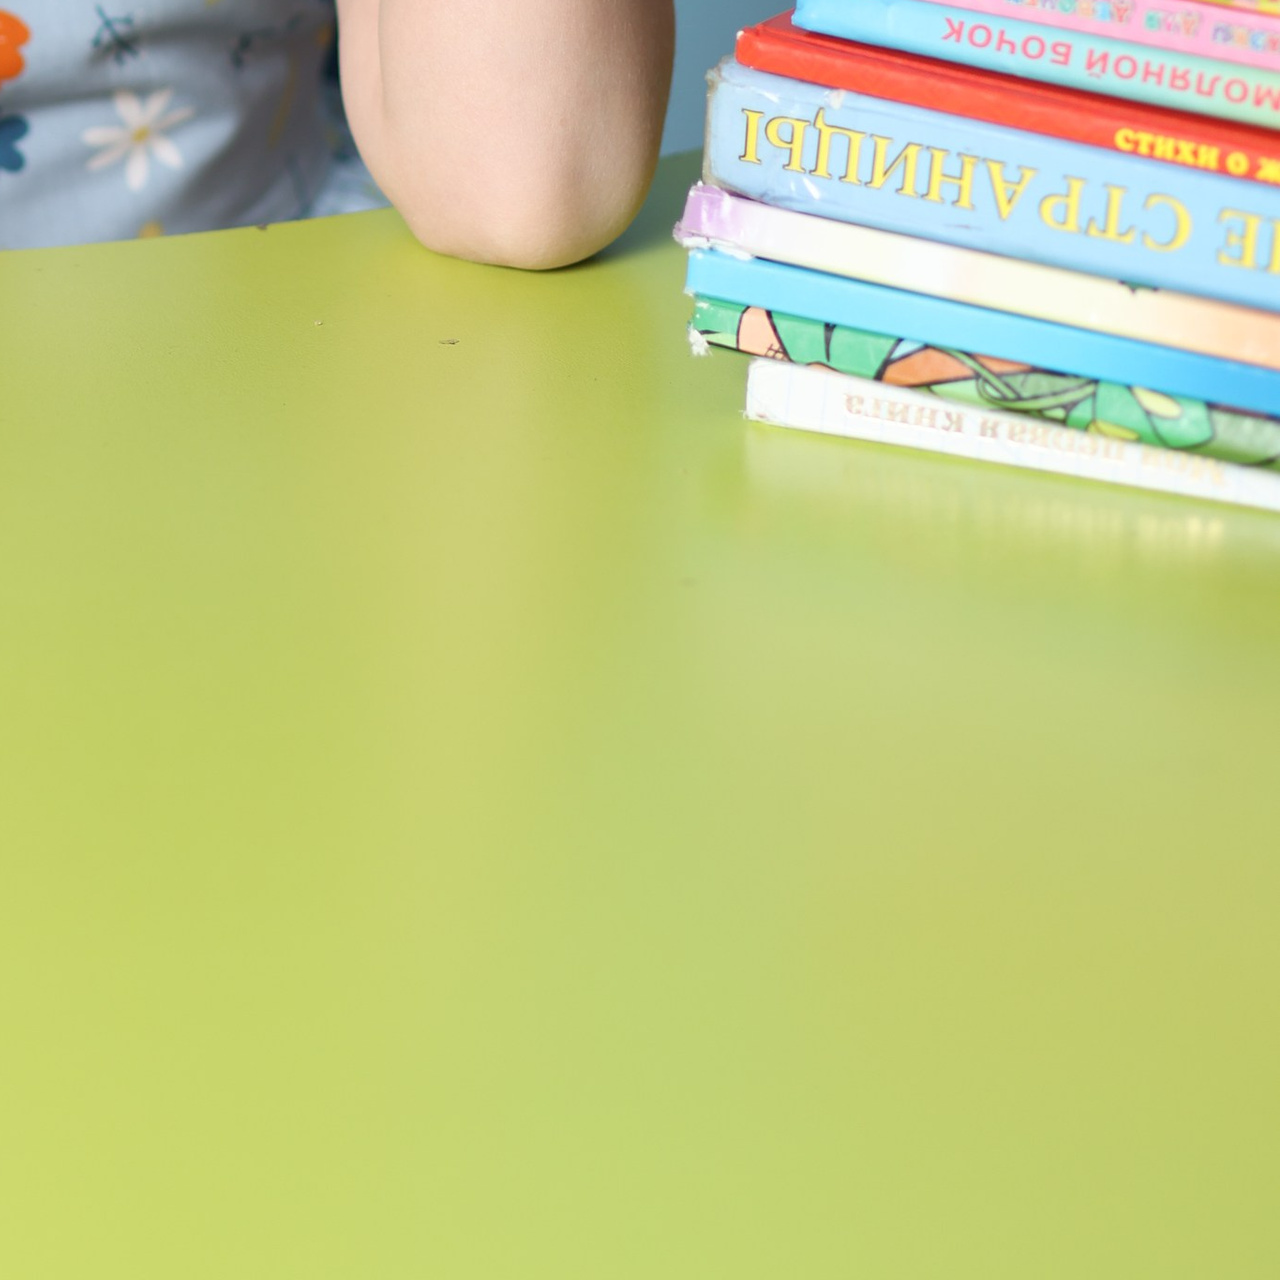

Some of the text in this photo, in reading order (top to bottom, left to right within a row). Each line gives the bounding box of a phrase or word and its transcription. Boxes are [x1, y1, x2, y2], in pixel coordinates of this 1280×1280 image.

[942, 17, 1072, 66] БОЧОК
[738, 106, 1193, 252] СТРАНИЦЫ
[844, 391, 967, 436] книга
